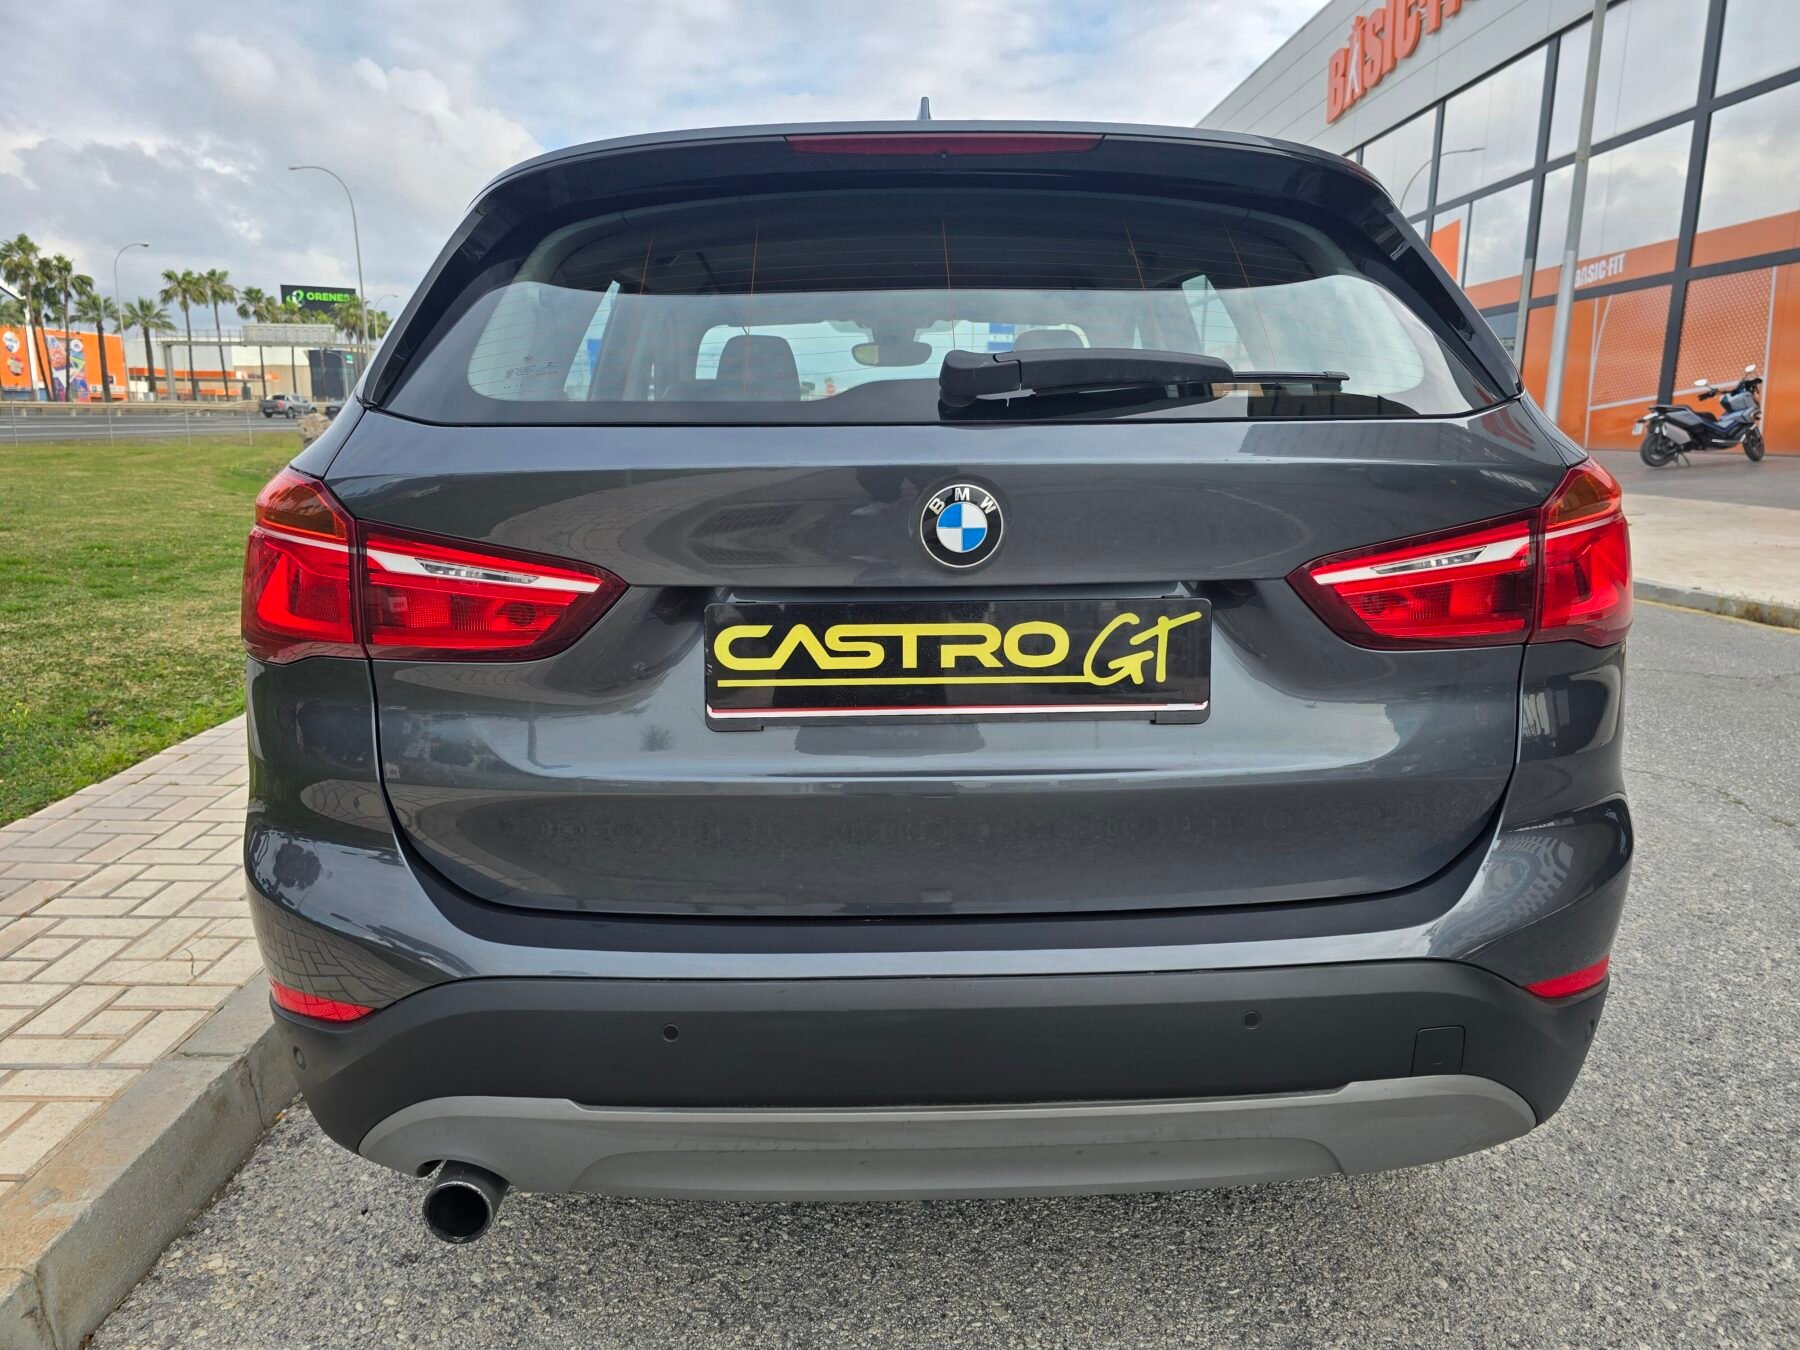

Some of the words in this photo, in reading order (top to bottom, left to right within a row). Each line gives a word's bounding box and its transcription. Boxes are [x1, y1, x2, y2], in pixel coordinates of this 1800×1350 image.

[1574, 252, 1626, 288] BASIC-FIT
[928, 487, 997, 516] BMW
[714, 622, 1069, 671] CASTRO
[1083, 612, 1202, 686] GT
